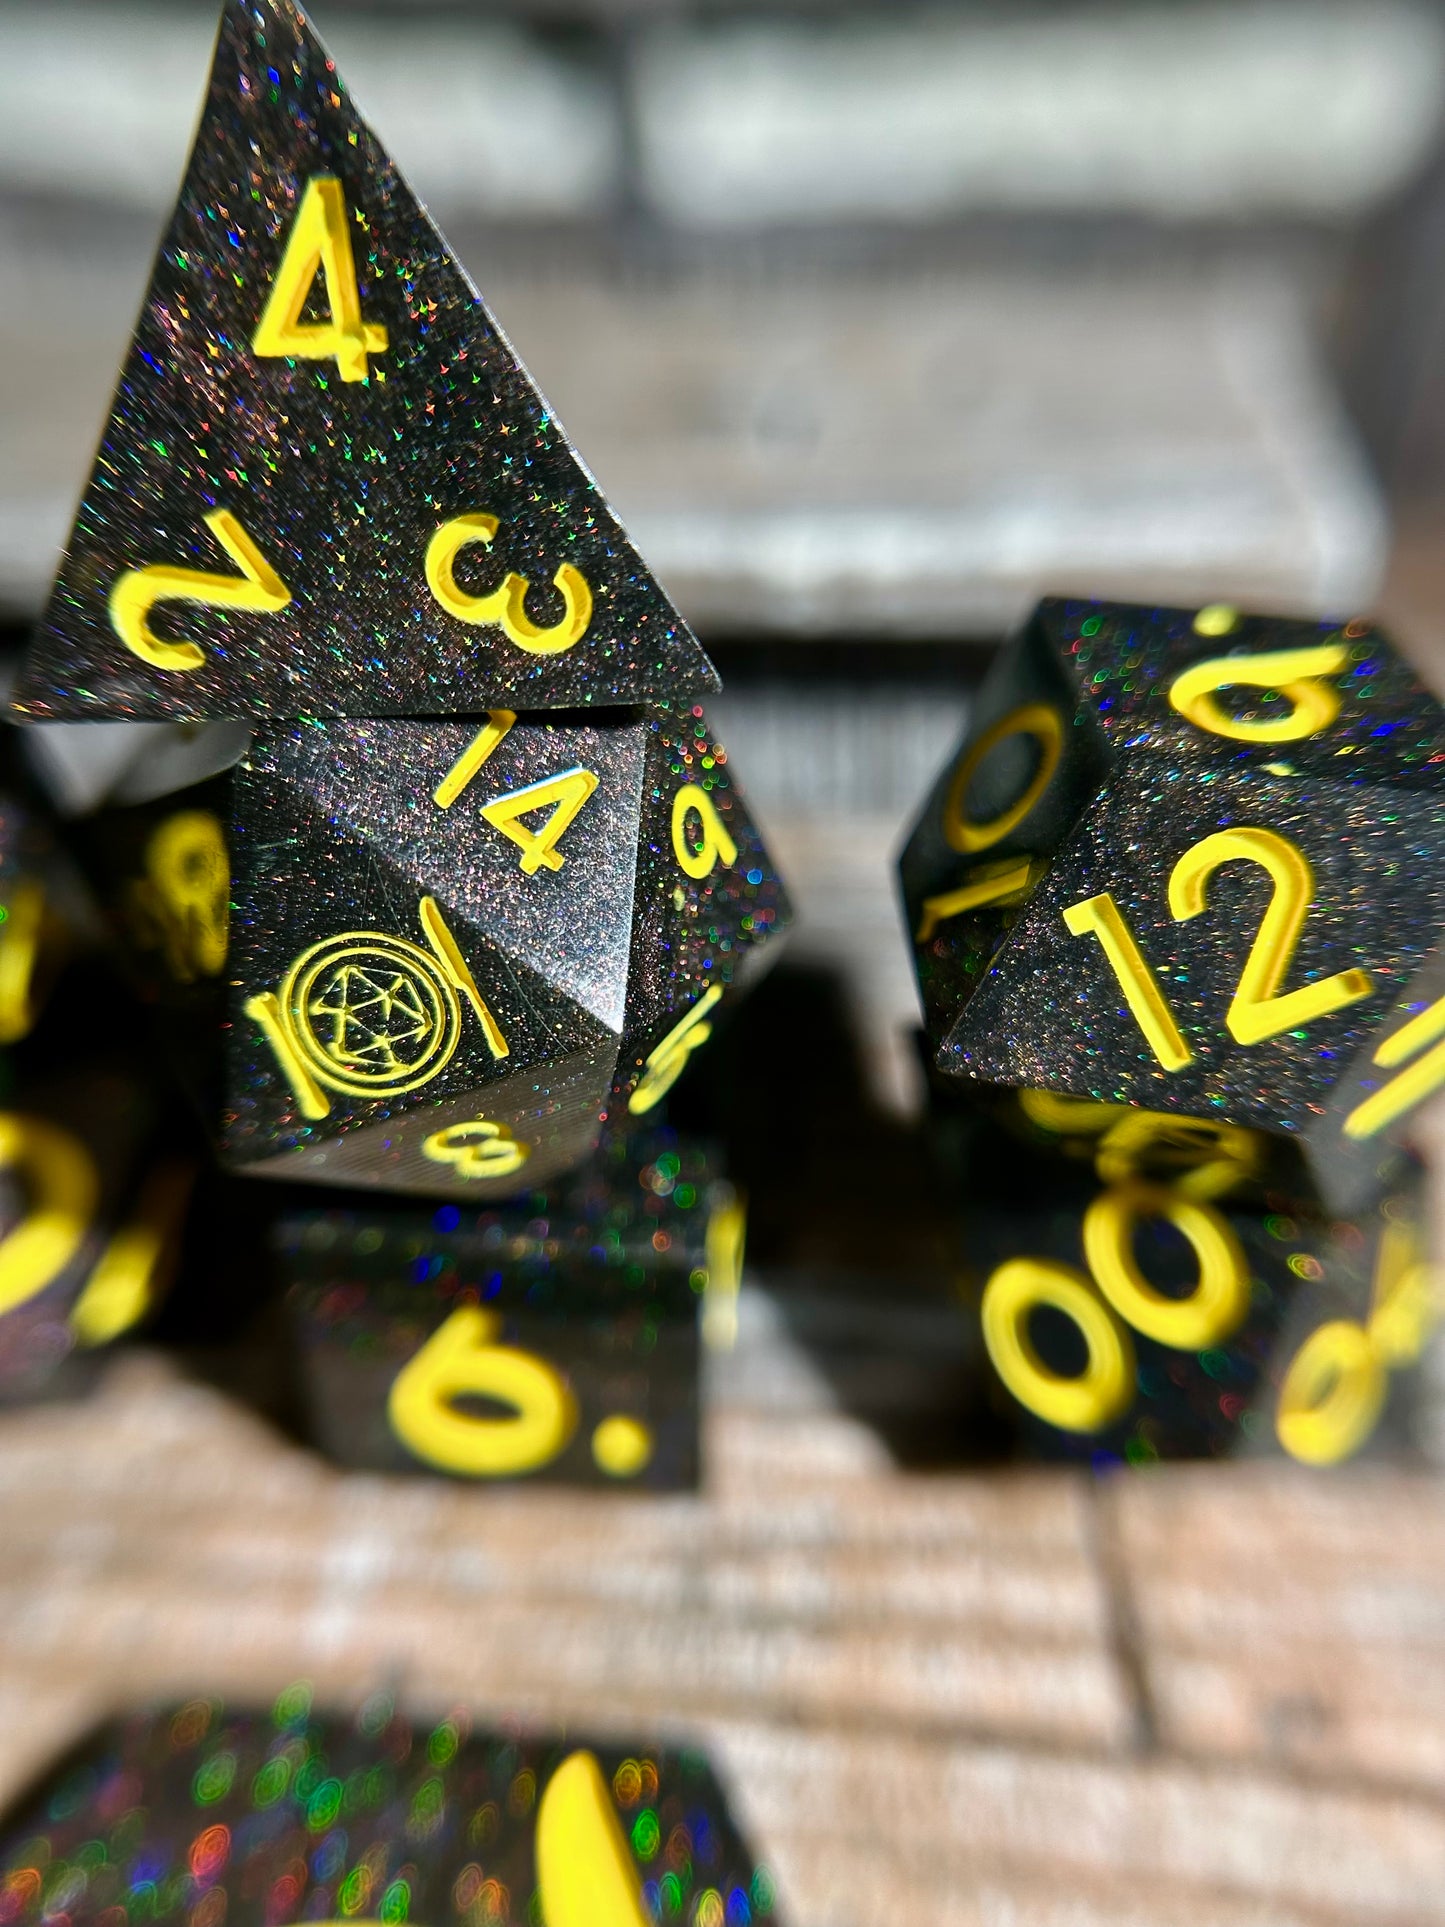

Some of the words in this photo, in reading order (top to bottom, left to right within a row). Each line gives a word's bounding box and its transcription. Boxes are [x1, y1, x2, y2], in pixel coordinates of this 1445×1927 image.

[252, 177, 389, 383] 4
[109, 506, 293, 673] 2
[424, 513, 594, 656] 3
[433, 710, 601, 876] 14
[1062, 826, 1374, 1073] 12
[421, 1120, 531, 1179] 8
[980, 1190, 1252, 1434] 00
